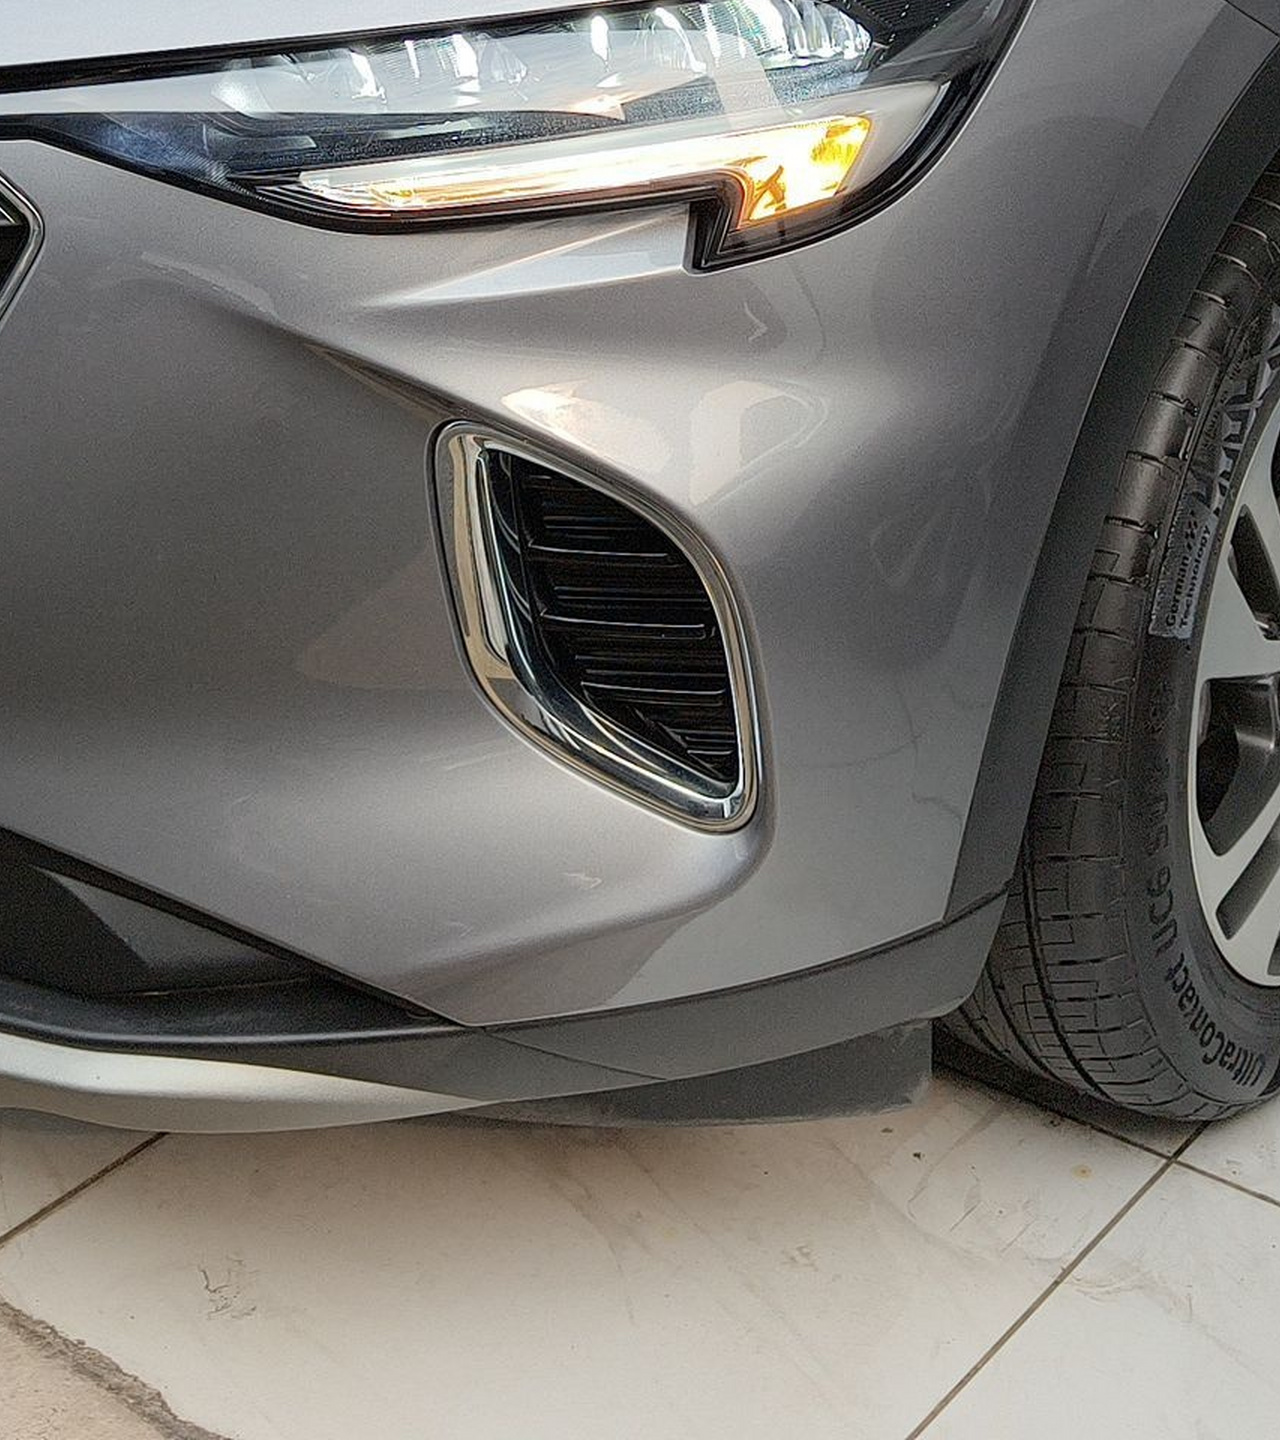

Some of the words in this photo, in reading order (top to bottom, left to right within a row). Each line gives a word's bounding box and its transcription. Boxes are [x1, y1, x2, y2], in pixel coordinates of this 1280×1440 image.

[1166, 556, 1190, 628] German
[1179, 525, 1212, 630] Technology
[1146, 865, 1179, 957] UC6
[1165, 952, 1268, 1088] UltraContact
